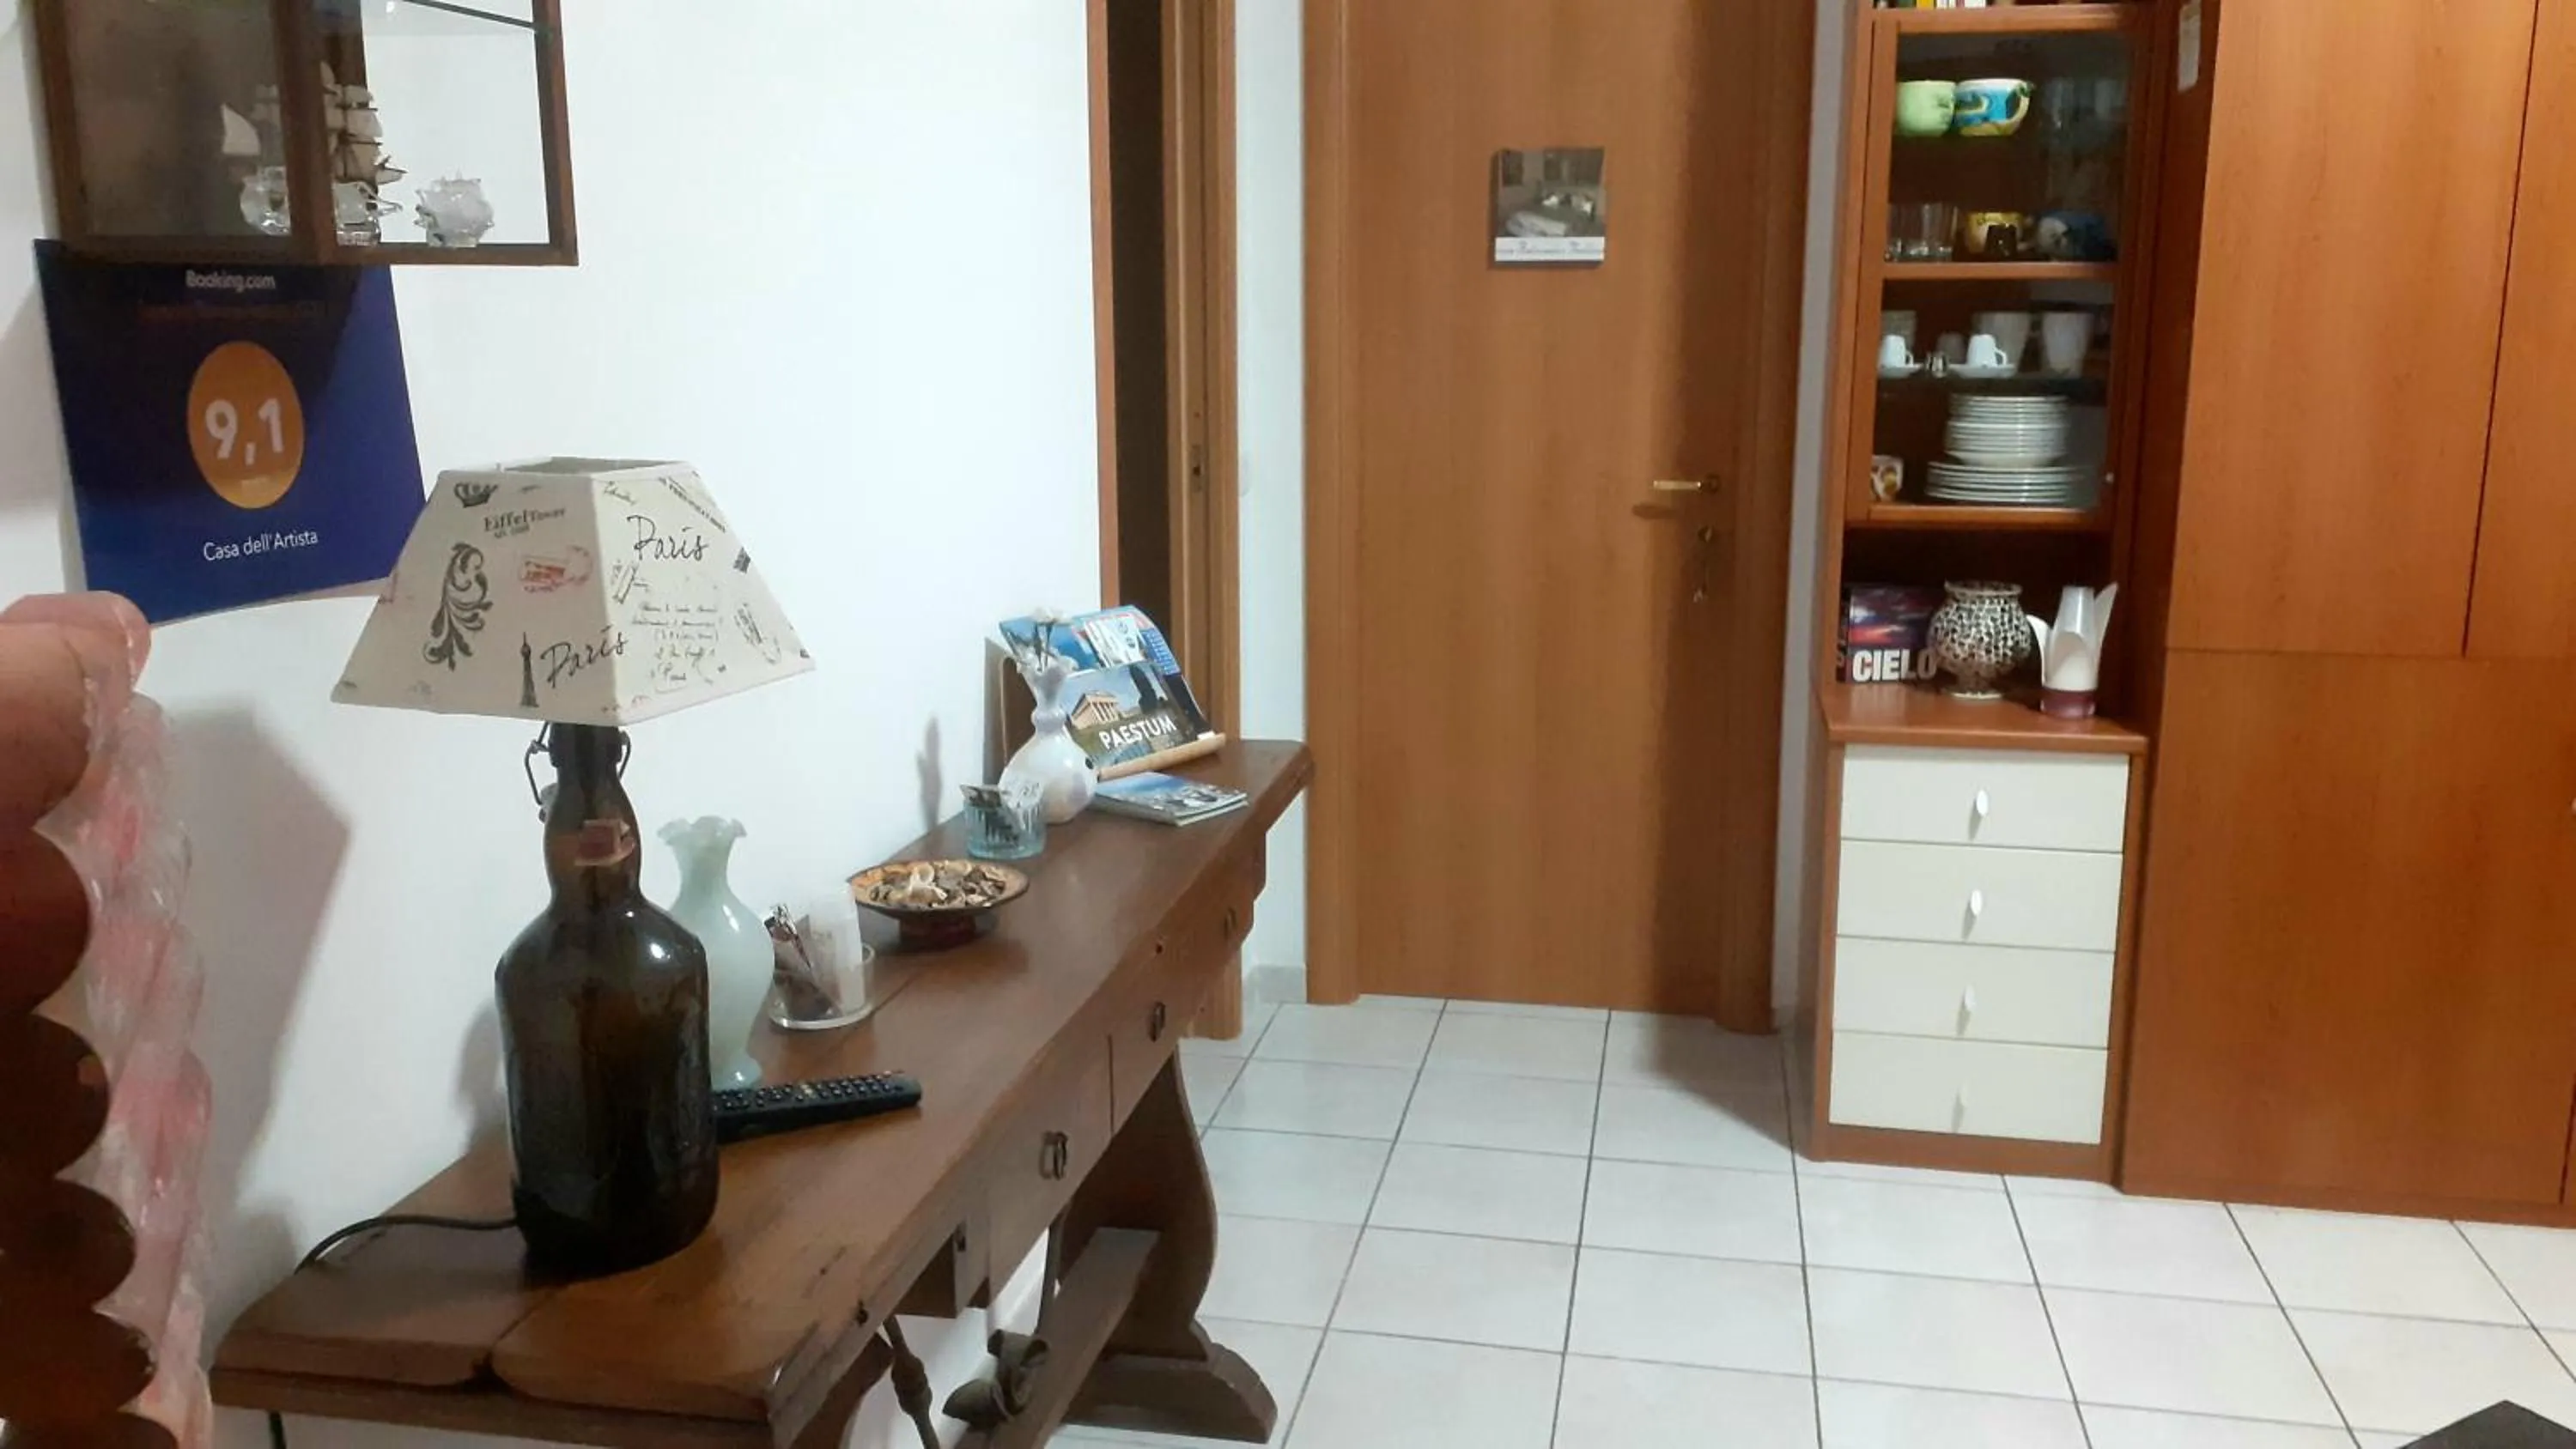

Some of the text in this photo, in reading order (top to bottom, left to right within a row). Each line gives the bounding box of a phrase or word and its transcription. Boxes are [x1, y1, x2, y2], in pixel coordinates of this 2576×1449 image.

[185, 270, 276, 293] Booking.com
[205, 398, 283, 466] 9,1
[203, 530, 319, 561] Casa dell'Artista
[626, 514, 709, 561] Paris
[540, 624, 628, 689] Paris
[1852, 648, 1937, 682] CIELO
[1098, 715, 1177, 750] PAESTUM
